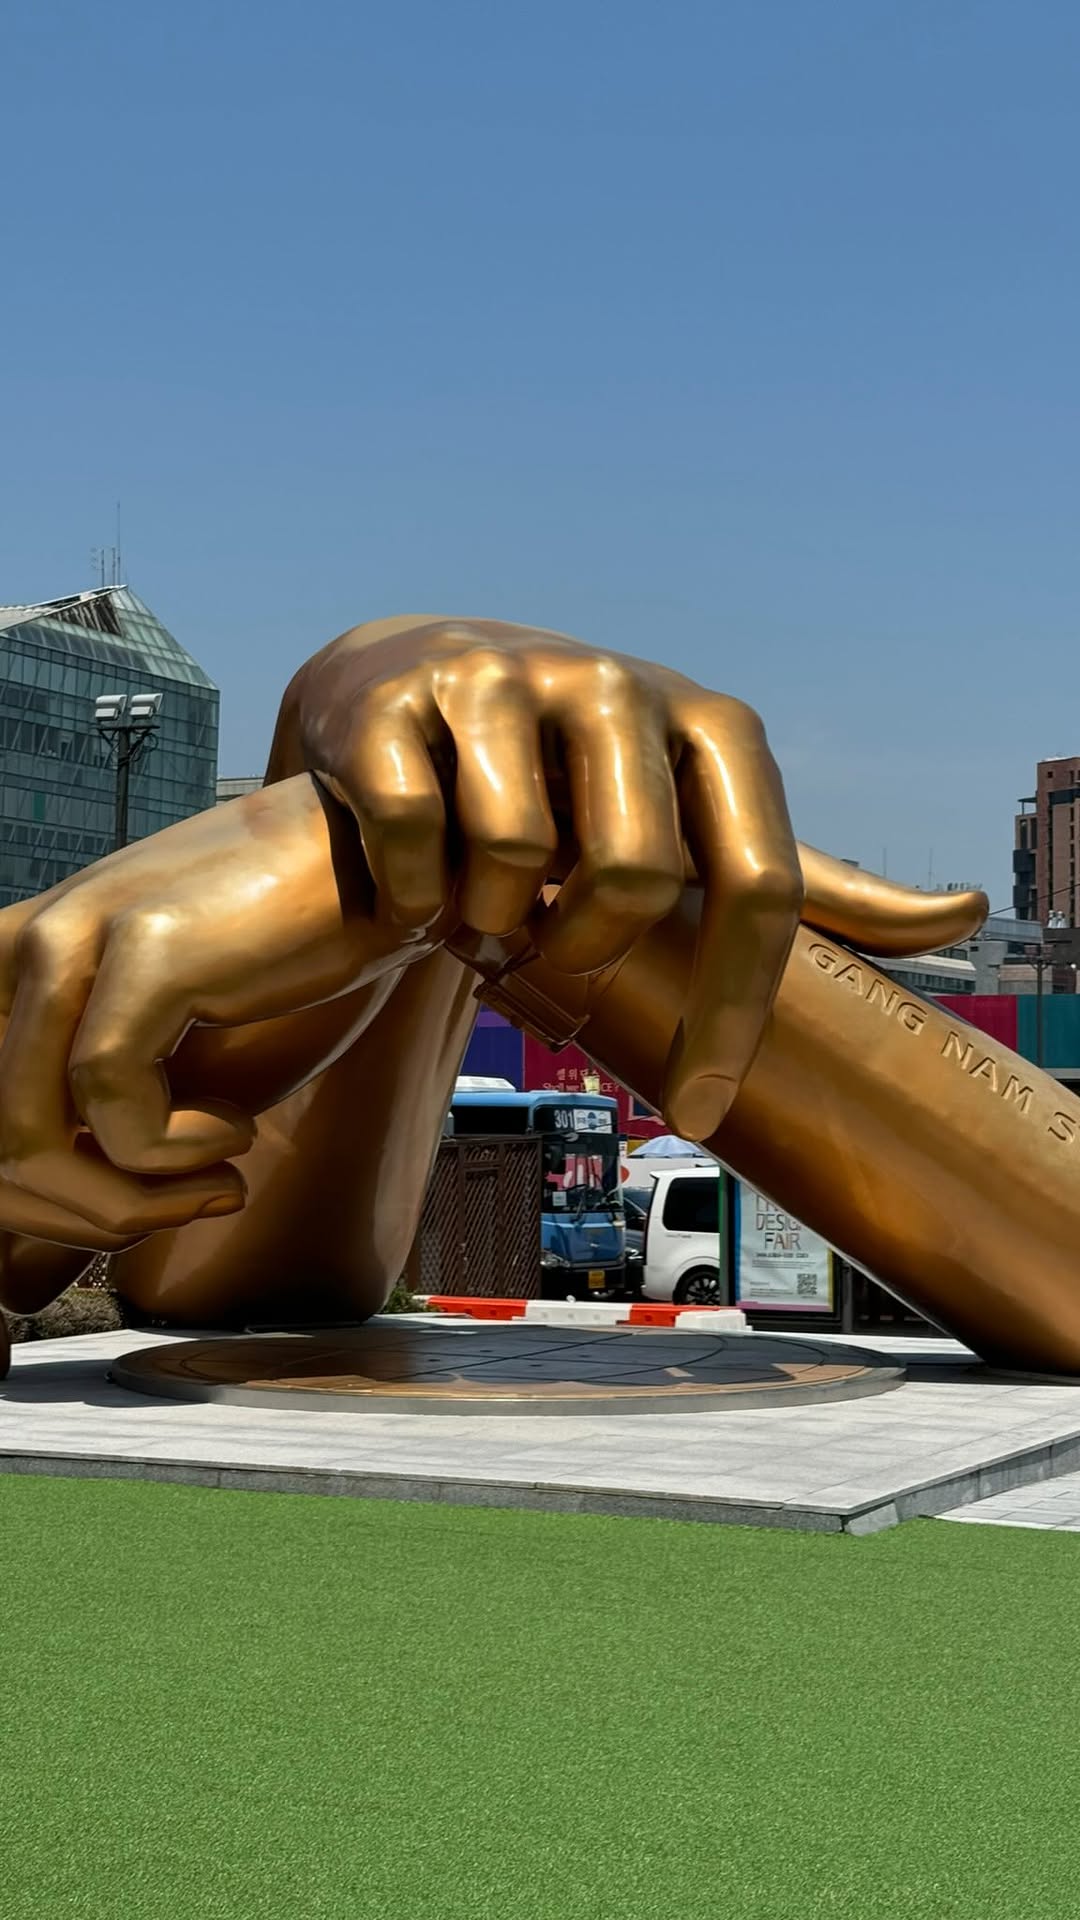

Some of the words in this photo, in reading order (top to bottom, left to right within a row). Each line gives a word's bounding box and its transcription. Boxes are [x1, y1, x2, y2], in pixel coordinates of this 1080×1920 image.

[808, 943, 928, 1036] GANG
[940, 1031, 1034, 1114] NAM
[554, 1109, 574, 1129] 301
[756, 1213, 801, 1232] DESIG
[764, 1232, 801, 1251] FAIR
